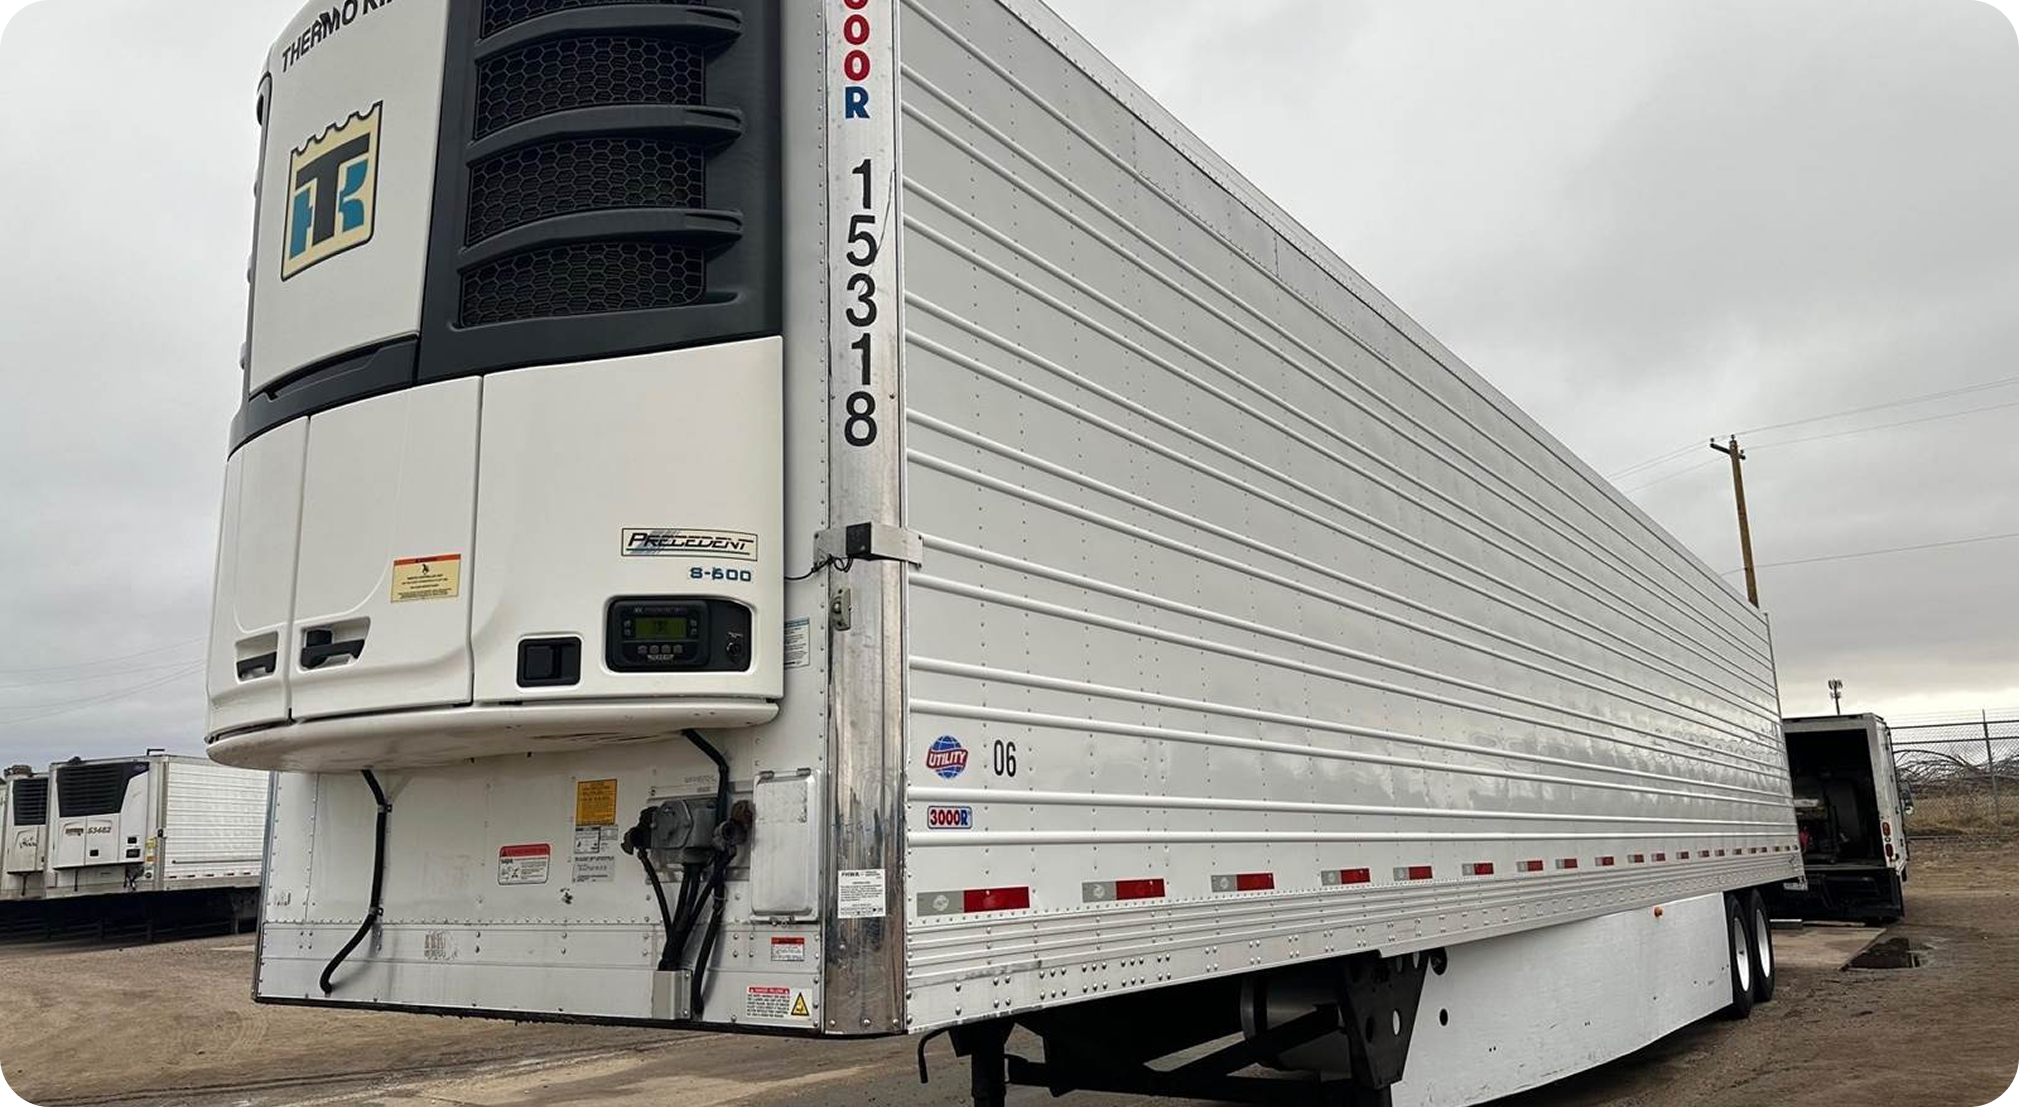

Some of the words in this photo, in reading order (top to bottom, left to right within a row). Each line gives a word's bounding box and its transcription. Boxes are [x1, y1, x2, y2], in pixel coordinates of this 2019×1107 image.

[282, 0, 359, 73] THERMO
[844, 159, 877, 446] 15318
[628, 532, 754, 551] PRECEDENT
[928, 751, 967, 767] UTILITY
[994, 739, 1017, 777] 06
[929, 809, 969, 826] 3000R
